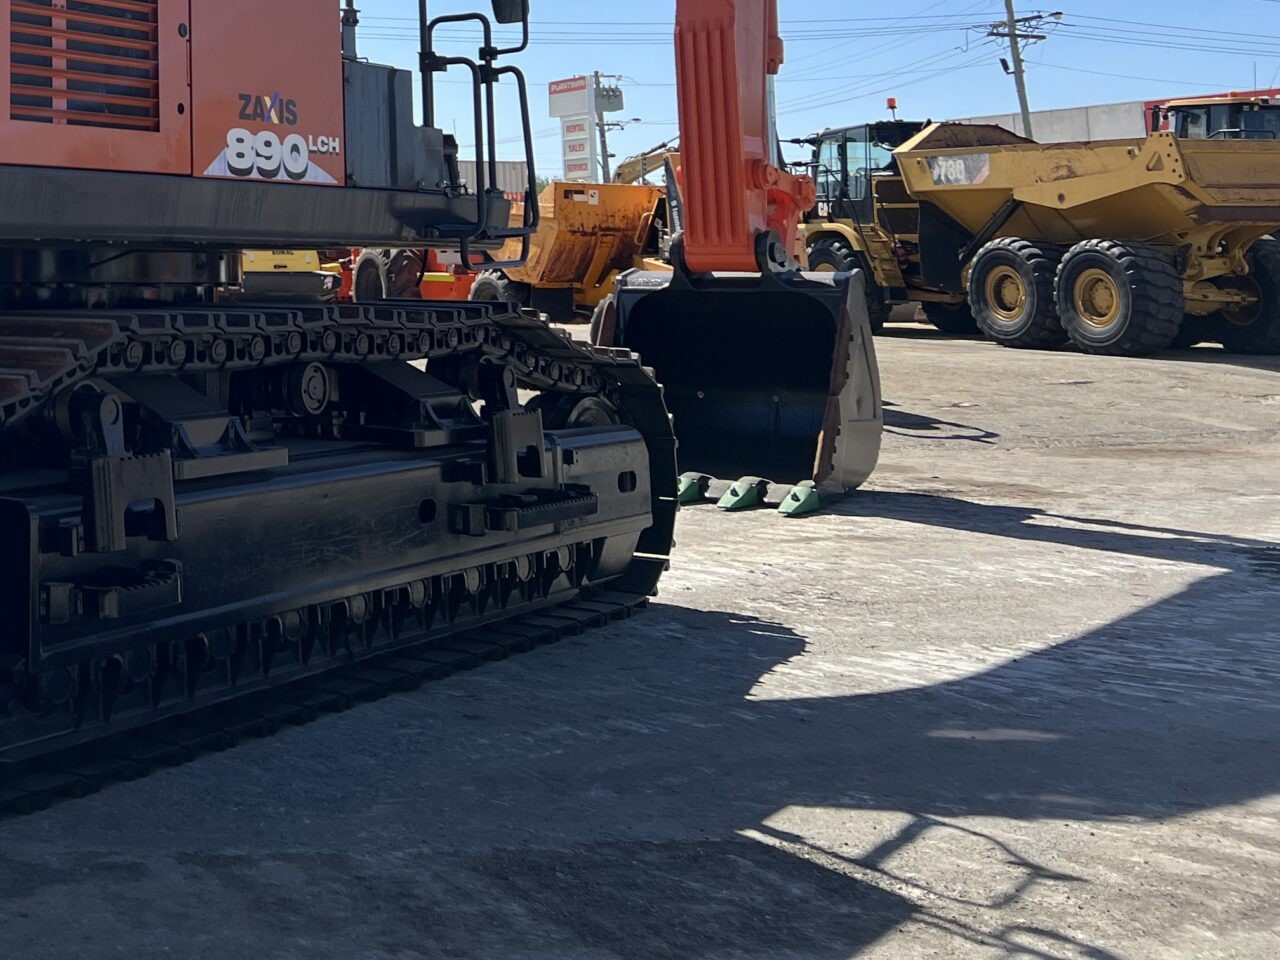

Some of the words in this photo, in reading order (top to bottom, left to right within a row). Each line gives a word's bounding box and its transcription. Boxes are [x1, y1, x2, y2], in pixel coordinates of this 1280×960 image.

[238, 91, 298, 126] ZAXIS
[566, 123, 586, 134] RENTAL
[227, 128, 309, 179] 890
[308, 135, 340, 155] LCH
[568, 143, 586, 153] SALES
[567, 162, 589, 173] SERVICE
